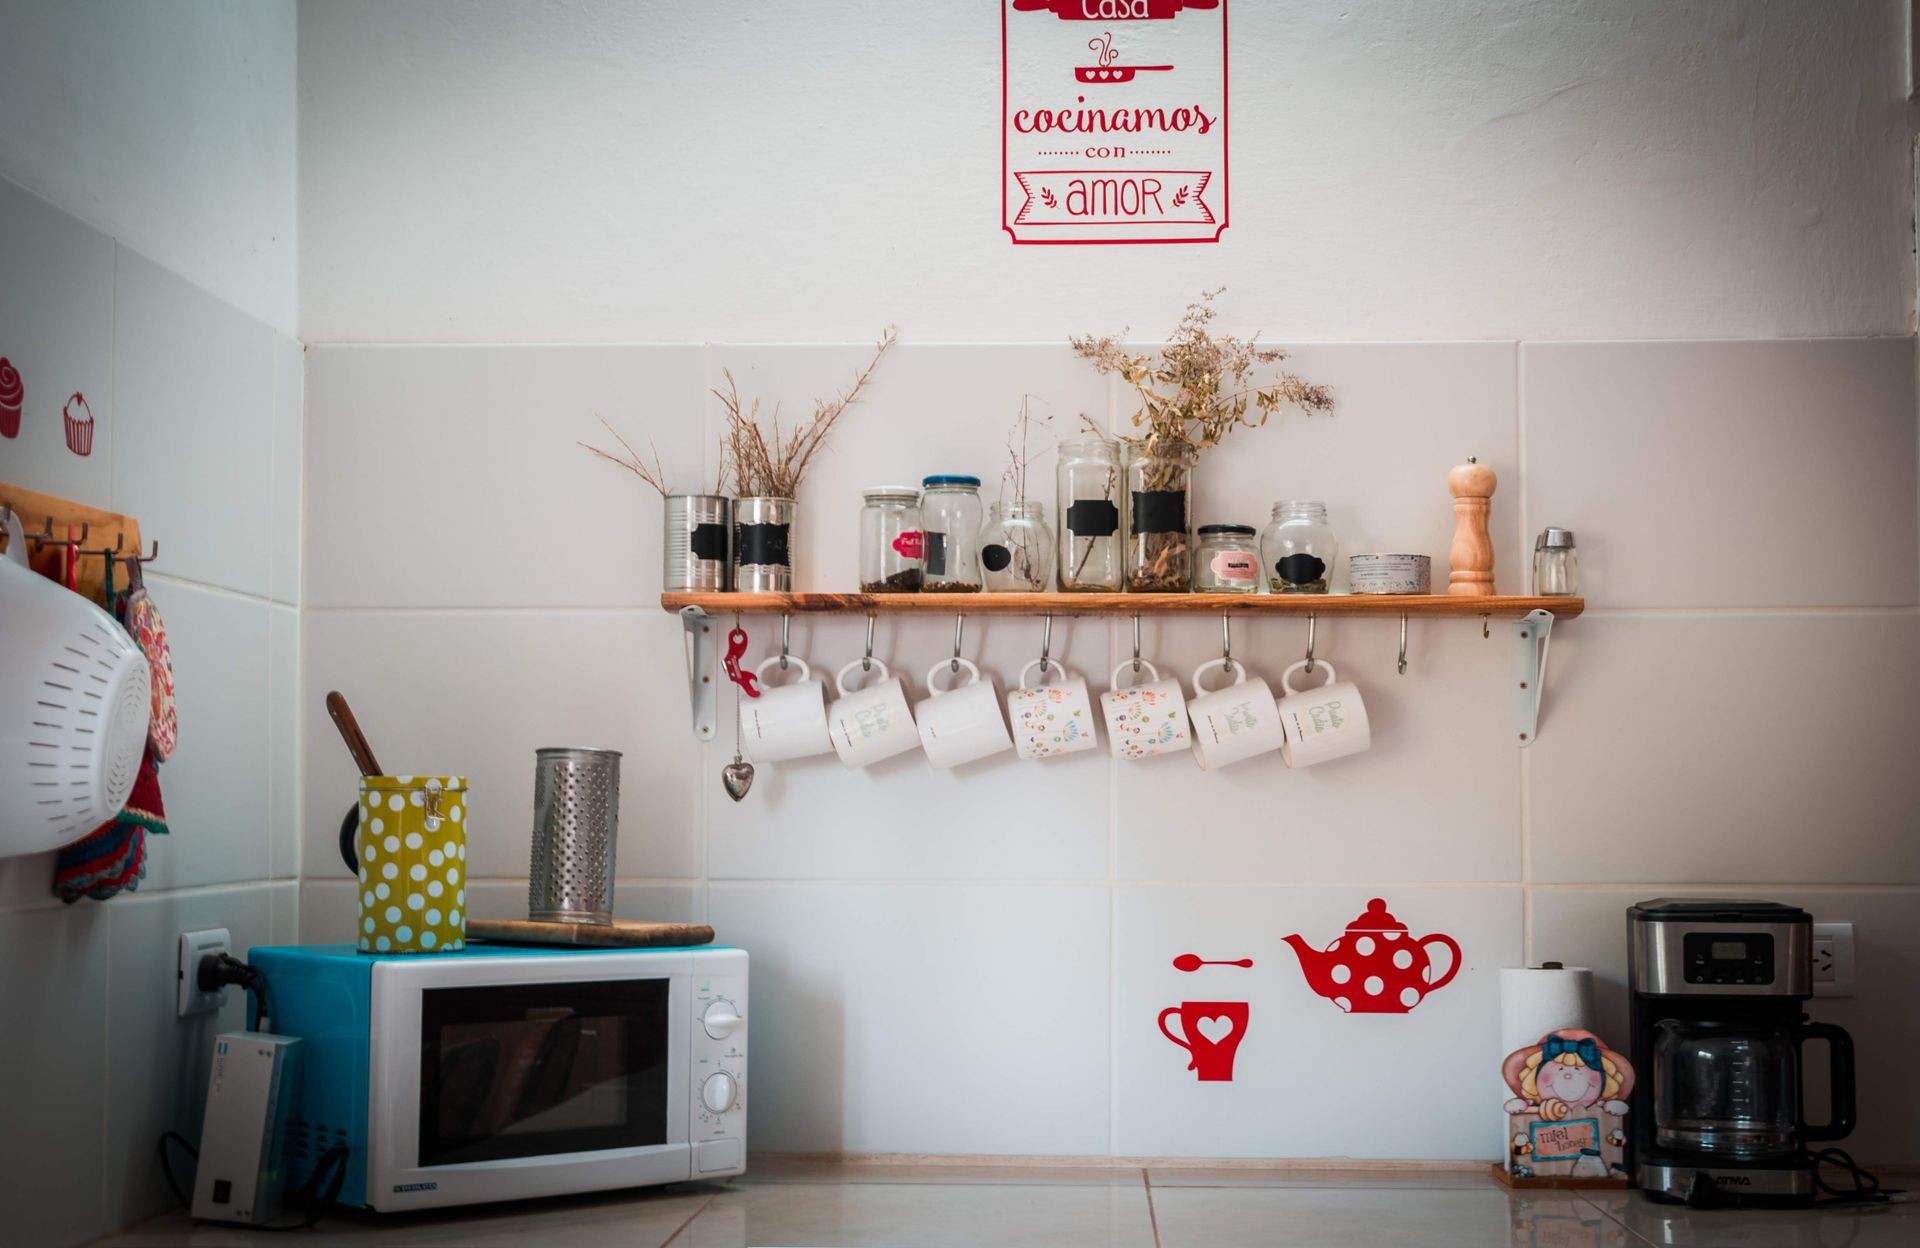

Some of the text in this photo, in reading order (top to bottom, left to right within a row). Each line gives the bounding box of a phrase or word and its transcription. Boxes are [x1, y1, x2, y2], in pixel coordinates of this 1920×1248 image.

[1014, 96, 1217, 135] cocinamos
[1085, 146, 1126, 159] con
[1715, 1176, 1751, 1185] ATMA
